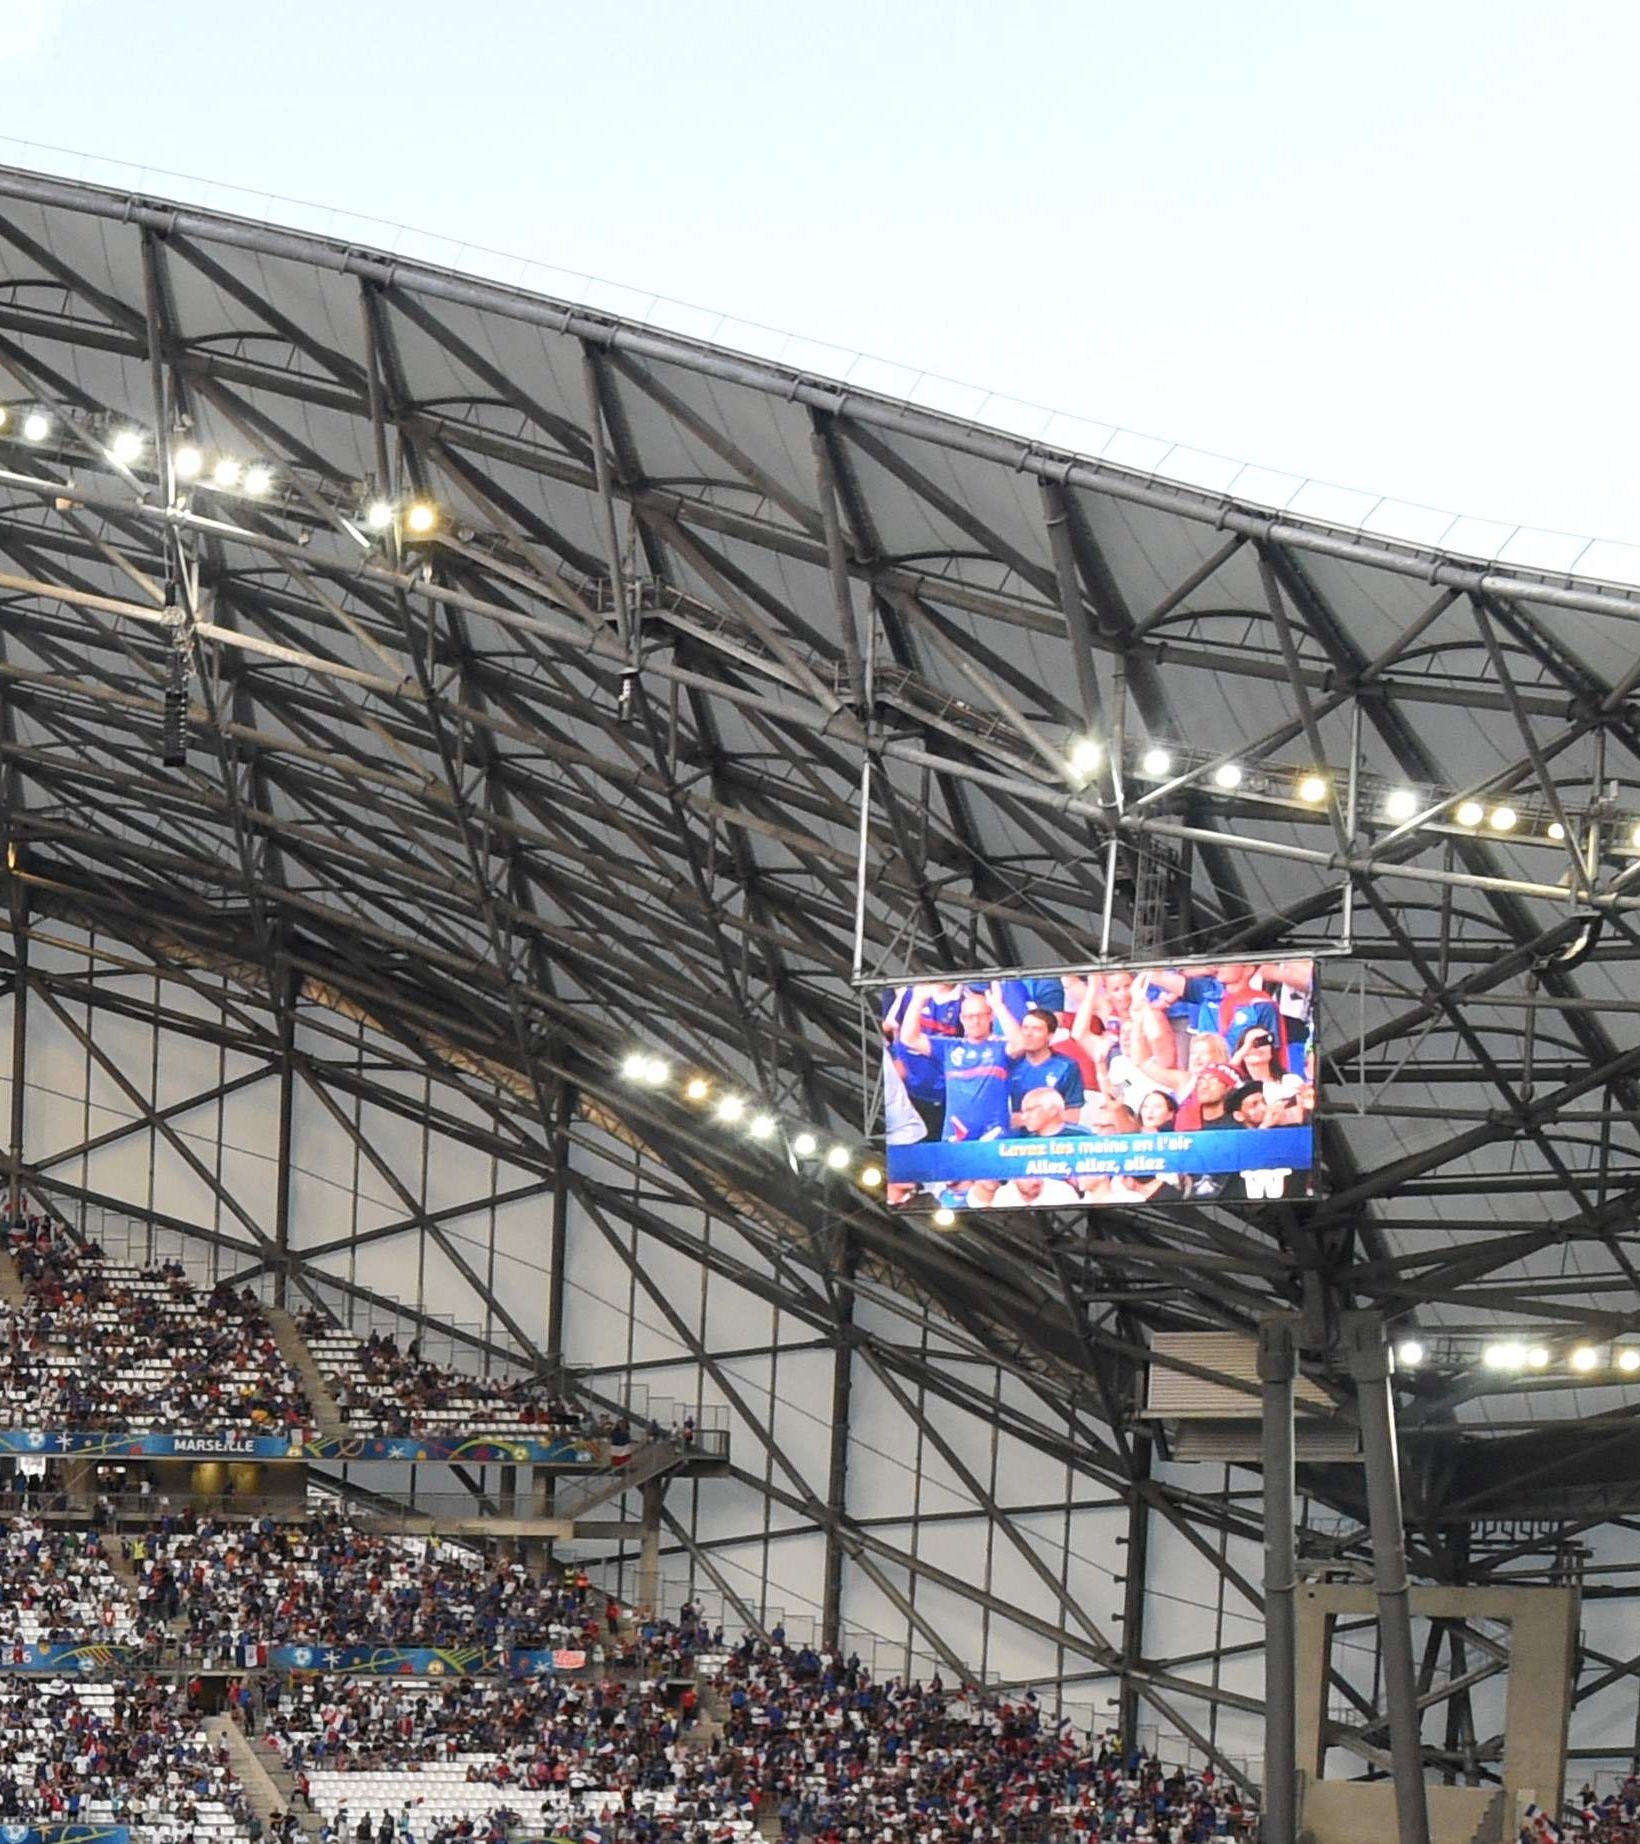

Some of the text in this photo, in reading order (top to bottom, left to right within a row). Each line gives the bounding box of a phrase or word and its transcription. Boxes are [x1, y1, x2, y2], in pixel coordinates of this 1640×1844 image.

[1050, 1141, 1075, 1155] les
[1078, 1139, 1129, 1154] mains
[1132, 1139, 1154, 1151] en
[1124, 1156, 1165, 1170] allez
